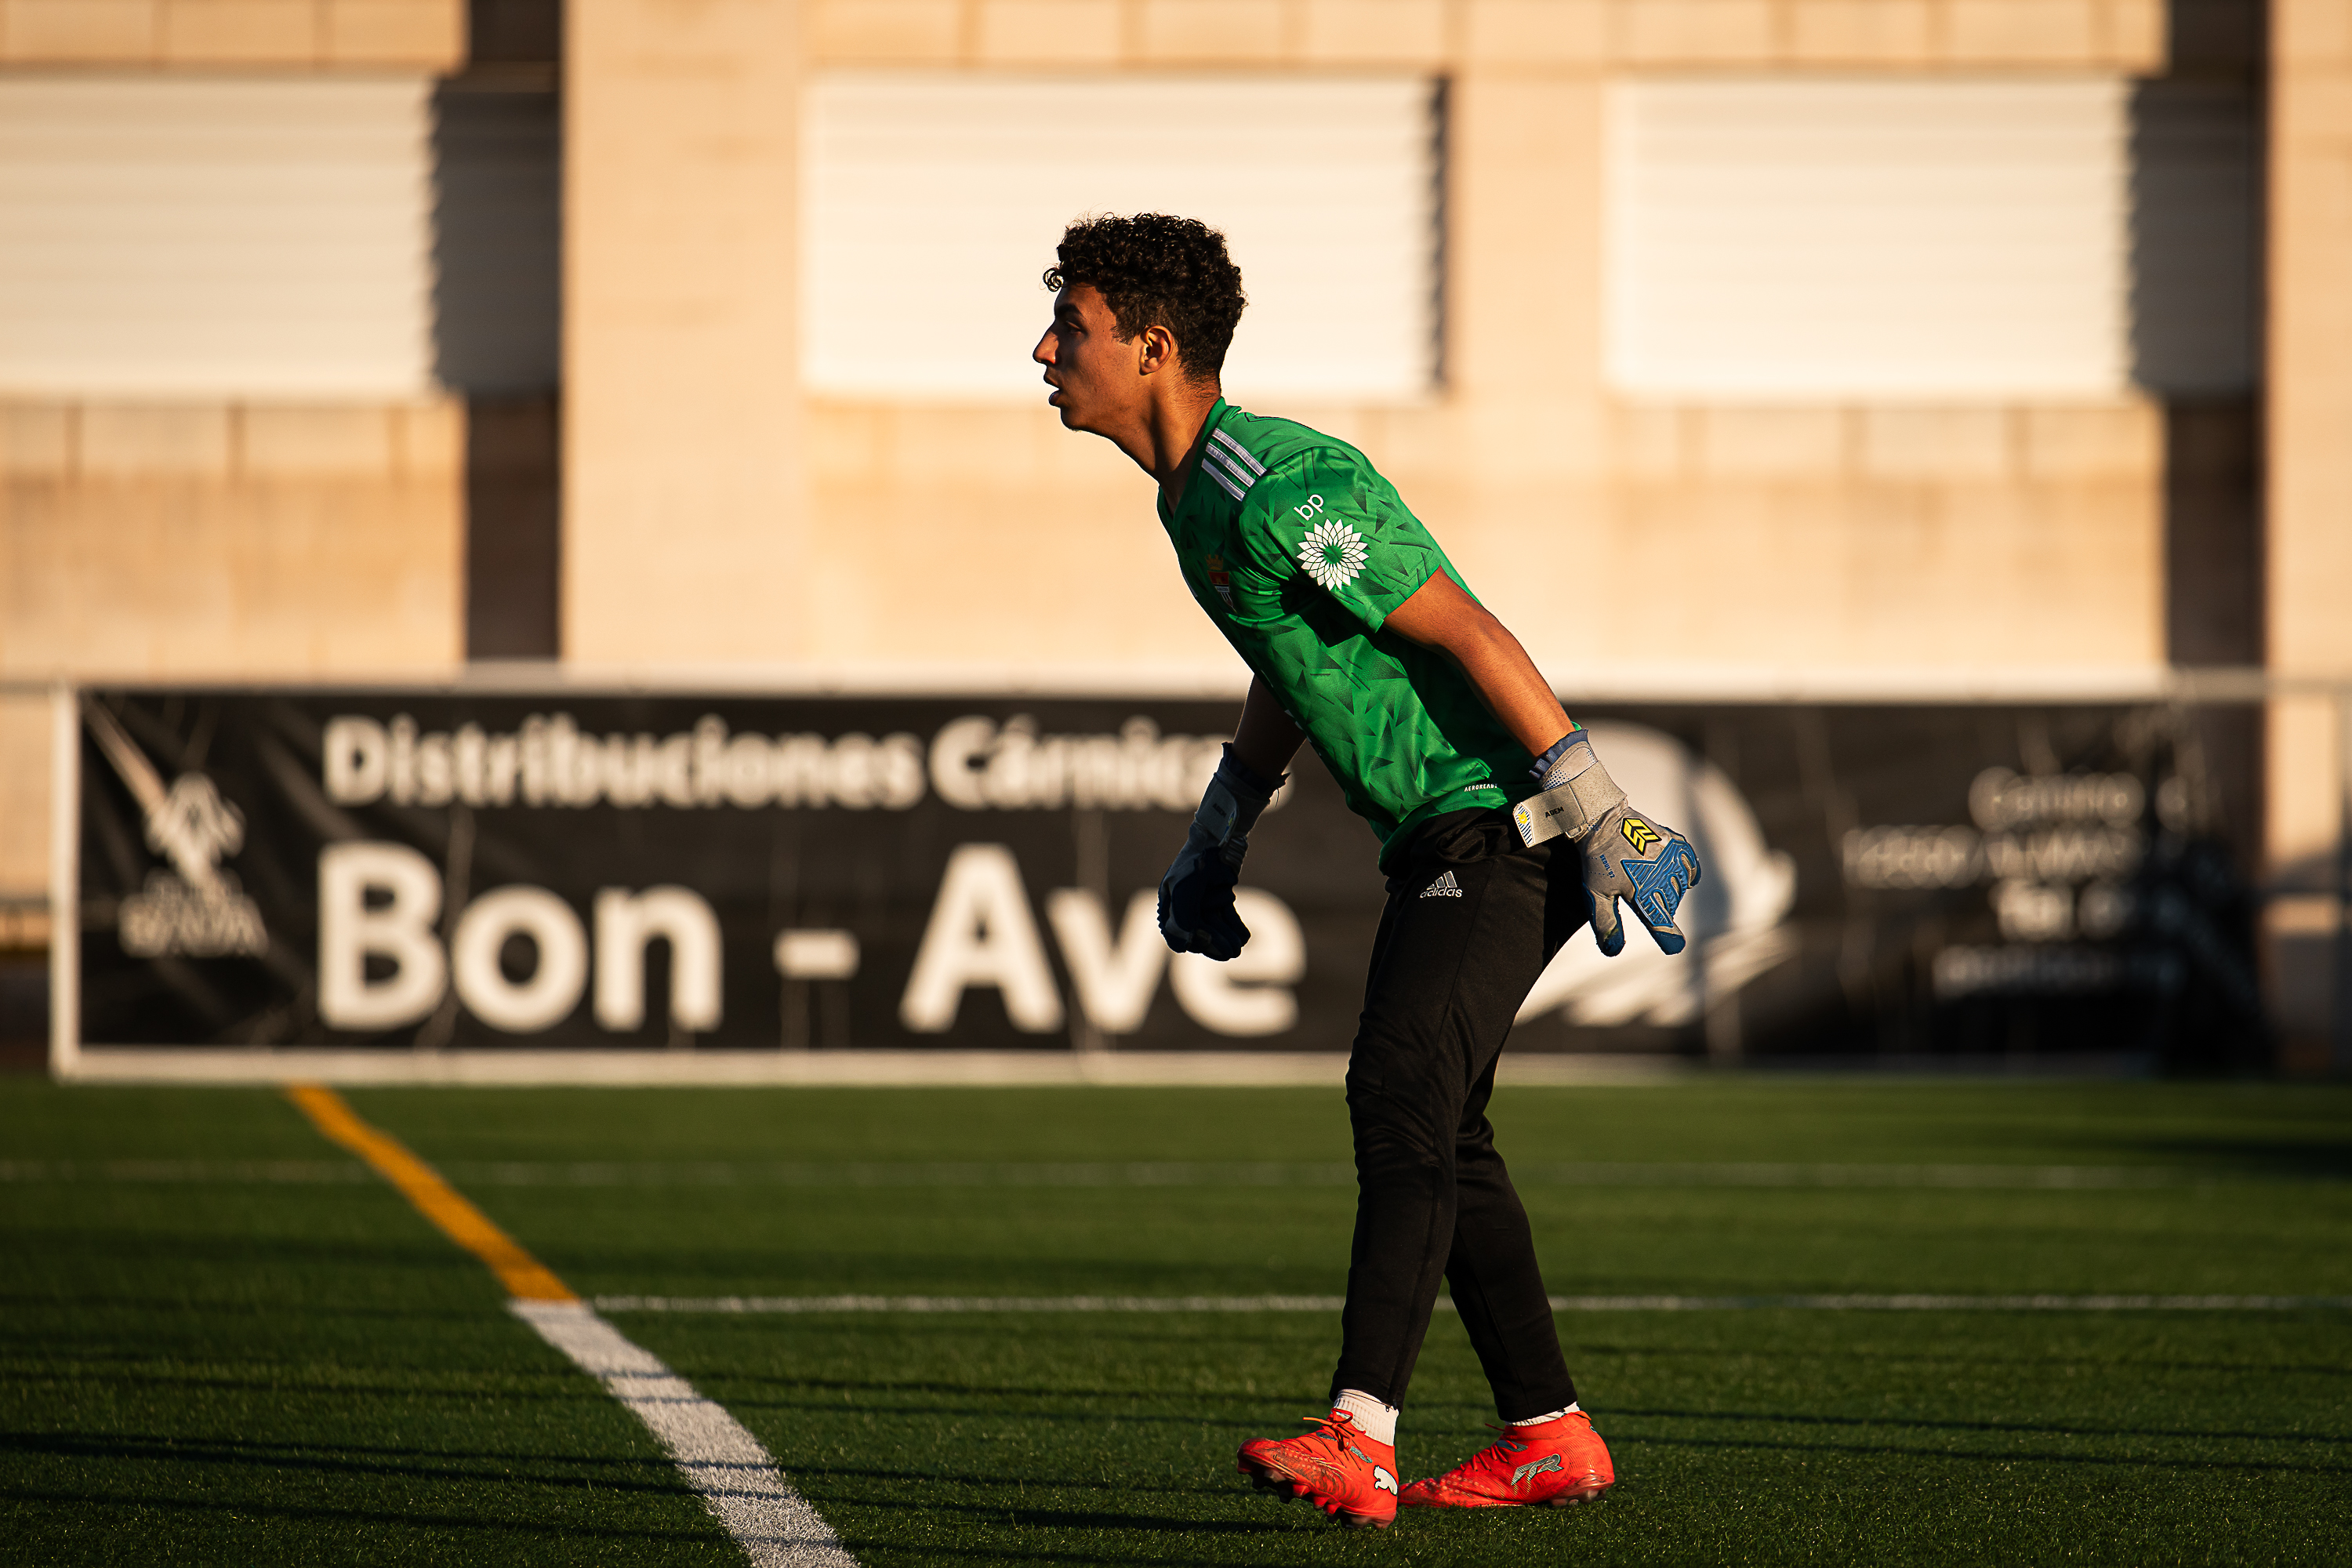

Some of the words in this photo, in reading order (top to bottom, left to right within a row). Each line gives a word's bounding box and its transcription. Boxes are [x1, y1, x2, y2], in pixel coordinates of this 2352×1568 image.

[1294, 494, 1324, 521] bp
[323, 713, 924, 809] Distribuciones
[1544, 806, 1565, 818] ADEM
[1420, 887, 1463, 898] adidas
[317, 841, 723, 1033] Bon
[900, 841, 1306, 1036] Ave
